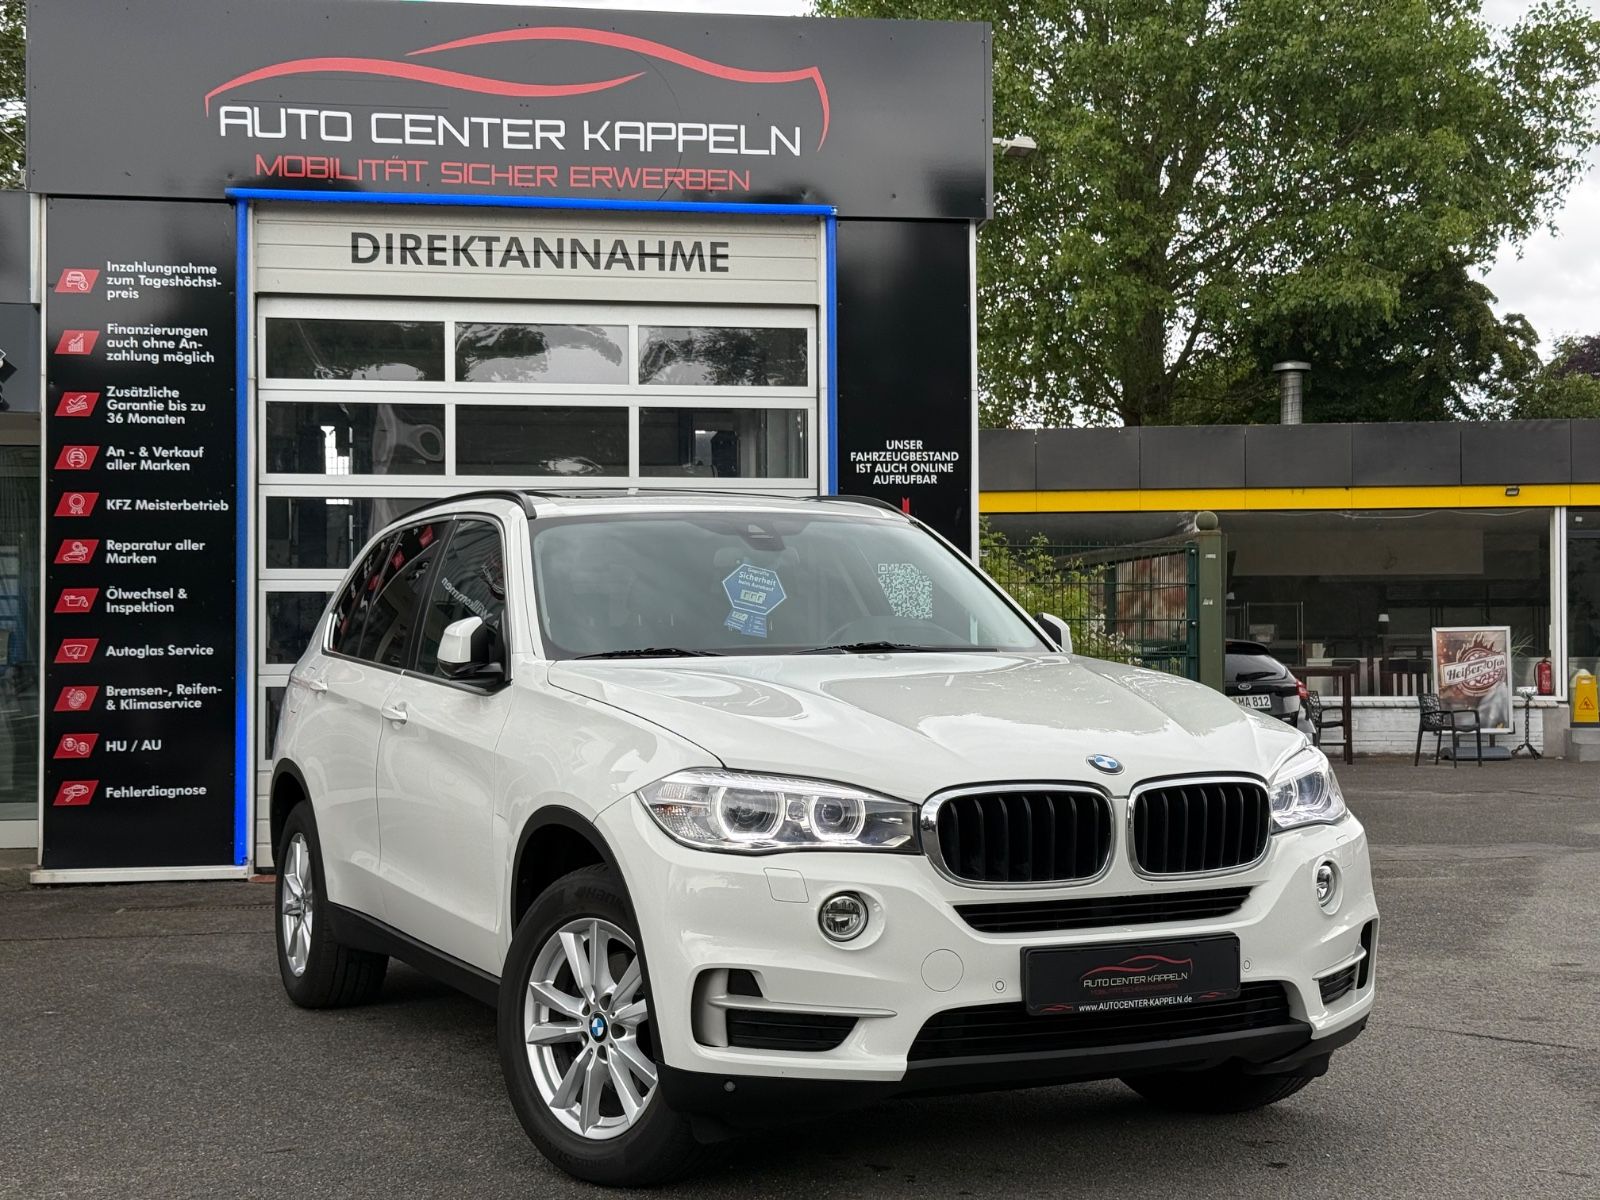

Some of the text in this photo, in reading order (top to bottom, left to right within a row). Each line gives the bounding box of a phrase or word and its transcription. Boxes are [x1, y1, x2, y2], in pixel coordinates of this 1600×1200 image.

[219, 105, 801, 157] AUTO CENTER KAPPELN
[255, 154, 750, 192] MOBILITÄT SICHER ERWERBEN
[350, 231, 729, 273] DIREKTANNAHME
[107, 261, 217, 275] Inzahlungnahme
[107, 275, 221, 288] zum Tageshöchst-
[107, 289, 139, 301] preis
[107, 324, 208, 338] Finanzierungen
[107, 338, 202, 349] auch ohne An-
[107, 351, 214, 364] zahlung möglich
[106, 386, 179, 398] Zusätzliche
[107, 400, 205, 412] Garantie bis zu
[106, 413, 185, 425] 36 Monaten
[886, 440, 923, 450] UNSER
[139, 447, 149, 457] &
[152, 447, 204, 458] Verkauf
[850, 451, 959, 462] FAHRZEUGBESTAND
[106, 460, 190, 471] aller Marken
[856, 463, 954, 473] IST AUCH ONLINE
[873, 475, 938, 485] AUFRUFBAR
[106, 499, 229, 511] KFZ Meisterbetrieb
[106, 539, 205, 552] Reparatur aller
[106, 553, 157, 564] Marken
[738, 571, 777, 588] Sicherheit
[106, 586, 187, 599] Ölwechsel &
[106, 602, 174, 615] Inspektion
[106, 645, 214, 658] Autoglas Service
[1446, 662, 1483, 681] Heißer
[106, 683, 222, 697] Bremsen-, Reifen-
[106, 698, 202, 710] & Klimaservice
[1238, 696, 1270, 707] MA 812
[106, 740, 162, 752] HU / AU
[106, 785, 207, 798] Fehlerdiagnose
[1083, 972, 1188, 988] AUTO CENTER KAPPELN
[1079, 995, 1193, 1012] www.AUTOCENTER-KAPPELN.de
